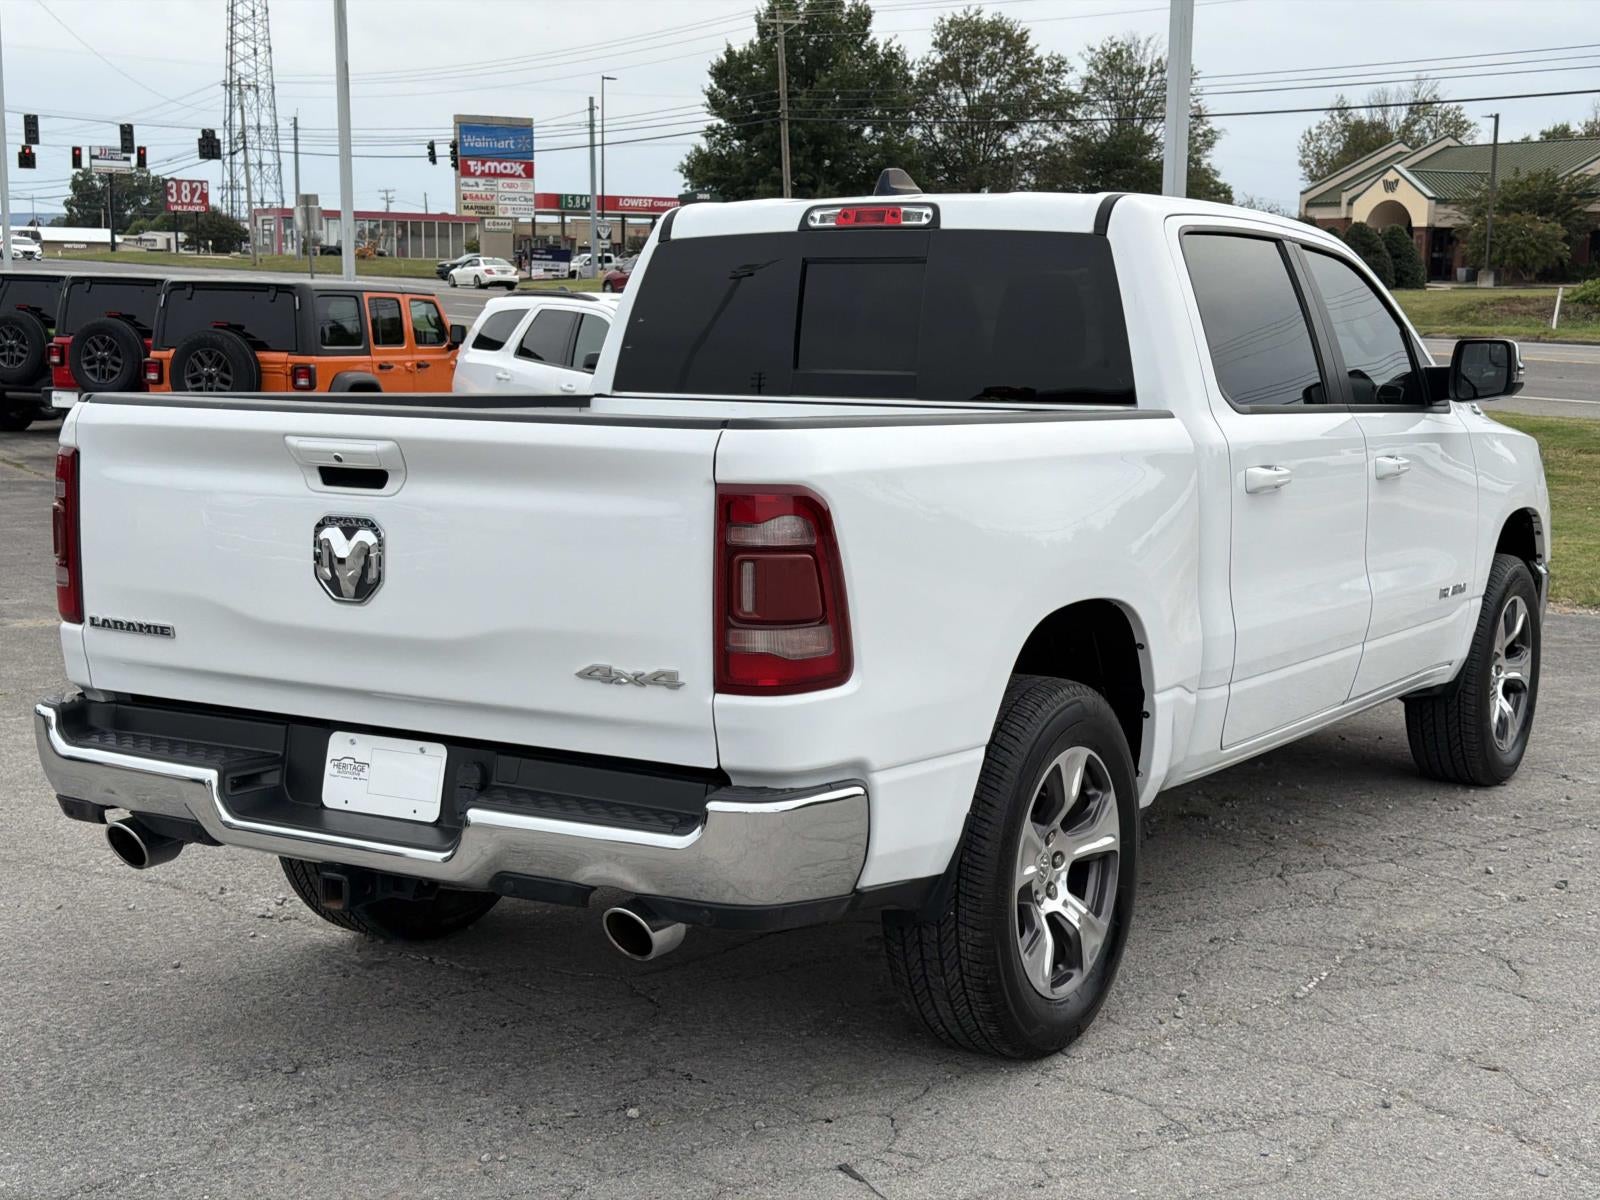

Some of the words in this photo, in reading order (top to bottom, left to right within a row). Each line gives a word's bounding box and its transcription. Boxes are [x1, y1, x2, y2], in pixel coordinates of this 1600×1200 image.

[463, 135, 515, 149] Walmart
[468, 193, 496, 201] SALLY
[170, 204, 206, 212] UNLEADED
[618, 198, 653, 208] LOWEST
[89, 616, 173, 637] LARAMIE
[332, 762, 366, 773] HERITAGE
